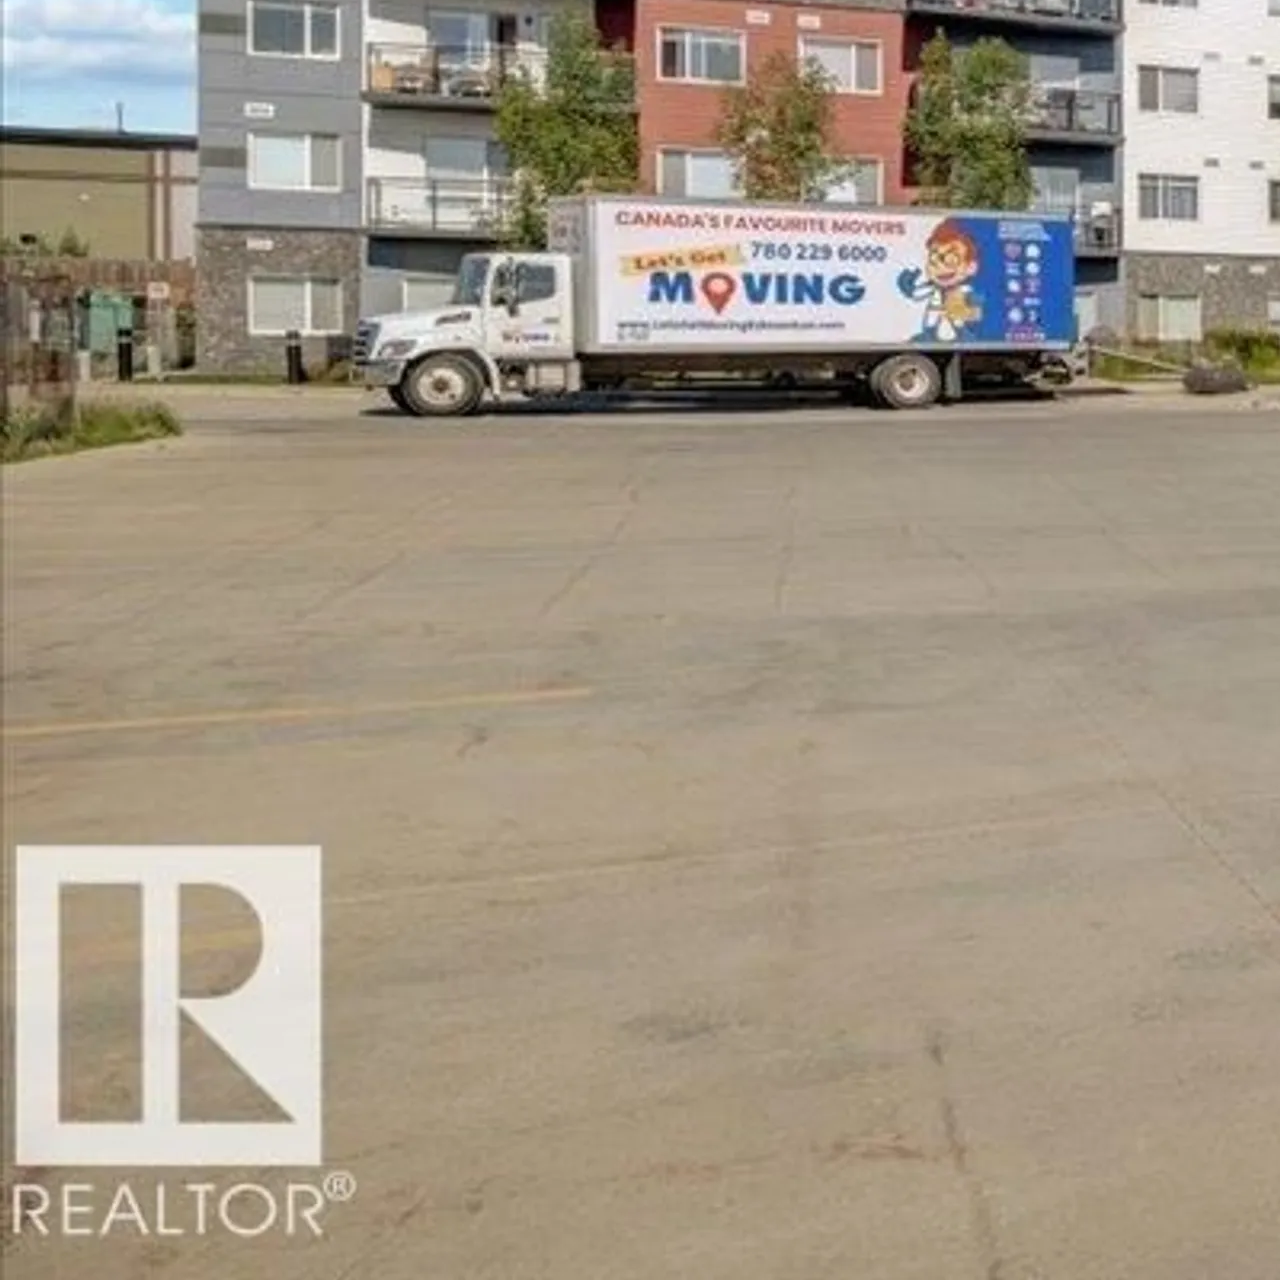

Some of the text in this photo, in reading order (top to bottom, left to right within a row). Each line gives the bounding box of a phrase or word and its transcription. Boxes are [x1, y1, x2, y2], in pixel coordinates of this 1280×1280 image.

[614, 211, 907, 237] CANADA'S FAVOURITE MOVERS
[633, 250, 727, 272] Let's Get
[751, 241, 887, 263] 780 229 6000
